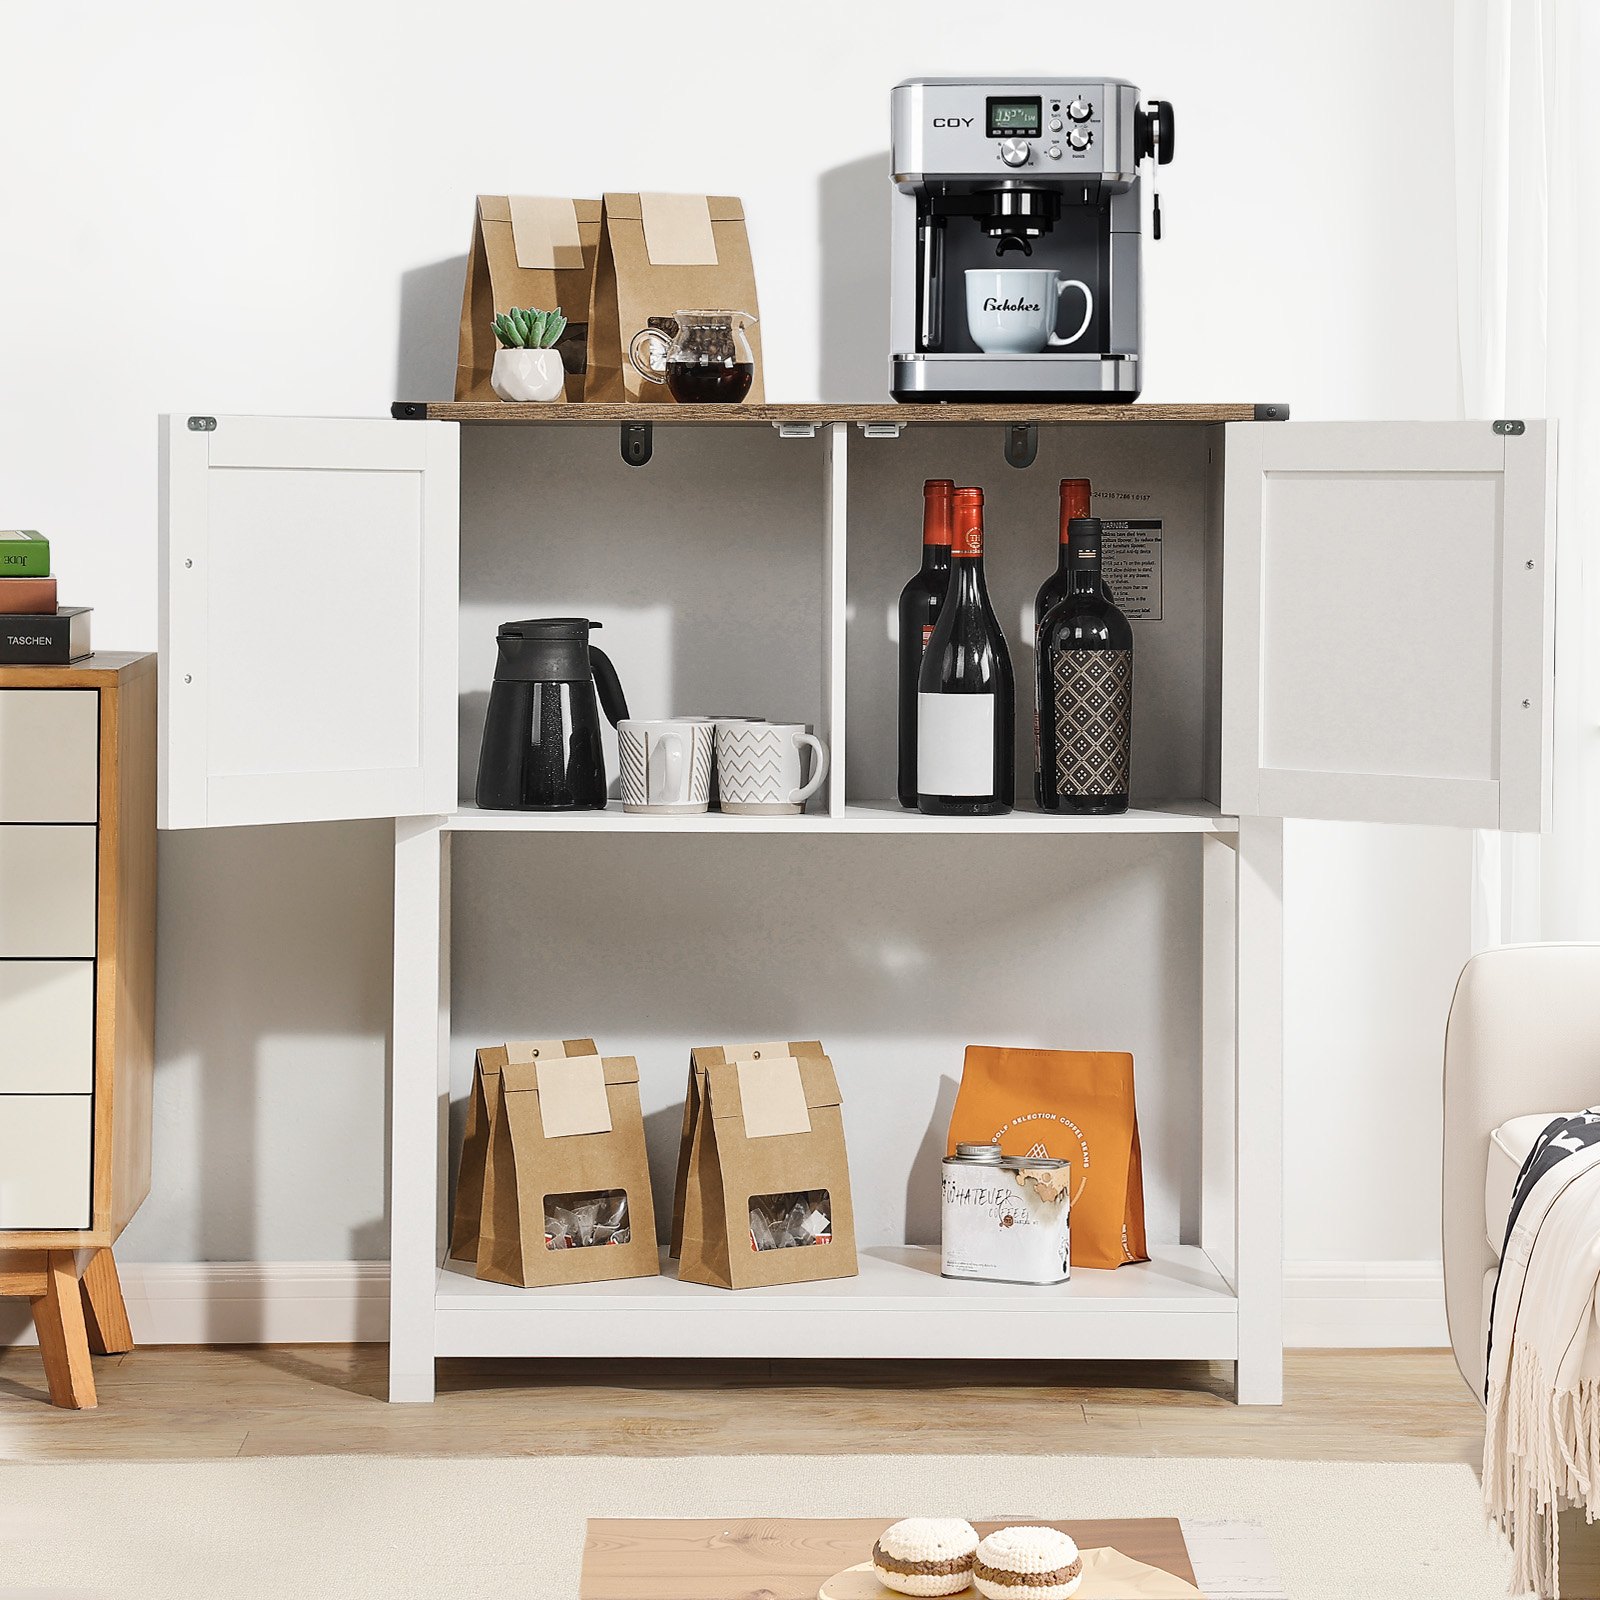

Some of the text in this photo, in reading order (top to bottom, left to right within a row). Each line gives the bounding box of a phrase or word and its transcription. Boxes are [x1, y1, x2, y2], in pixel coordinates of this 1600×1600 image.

[932, 117, 975, 128] COY
[4, 555, 28, 567] JUDE
[7, 635, 52, 646] TASCHEN
[1012, 1112, 1057, 1126] SELECTION
[1059, 1117, 1084, 1140] COFFEE
[1080, 1140, 1091, 1168] BEANS
[946, 1187, 1012, 1206] WHATEVER
